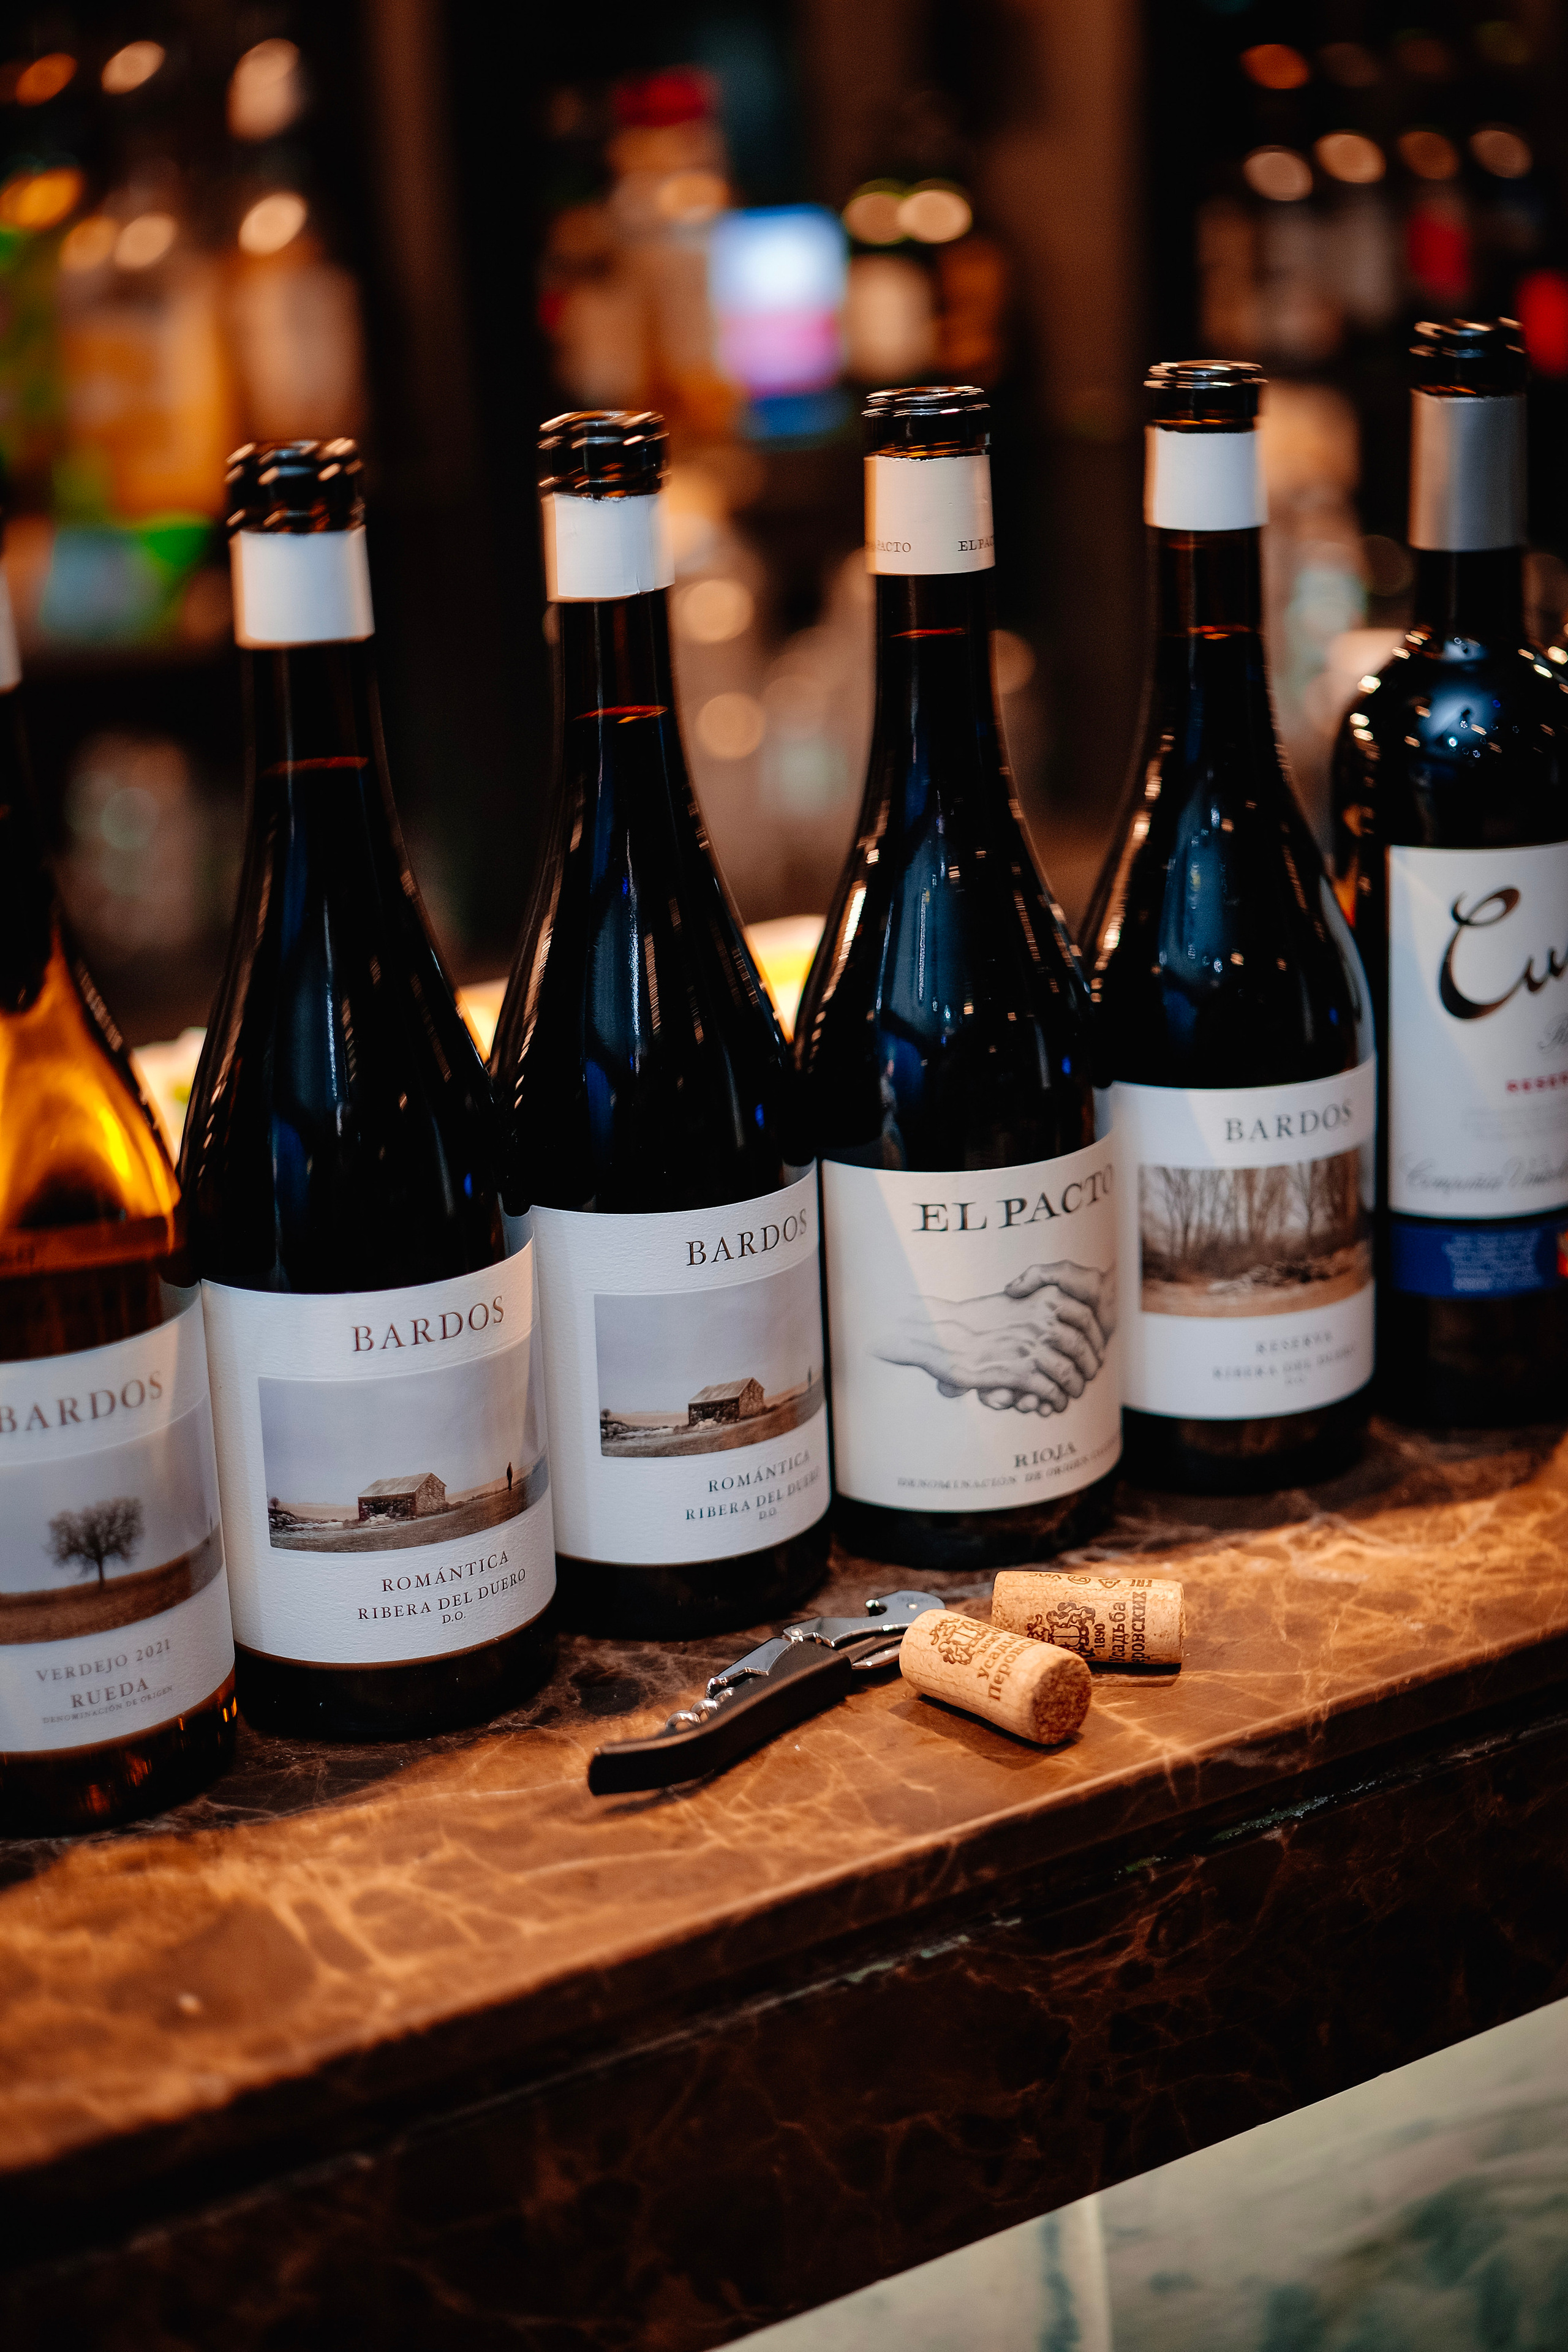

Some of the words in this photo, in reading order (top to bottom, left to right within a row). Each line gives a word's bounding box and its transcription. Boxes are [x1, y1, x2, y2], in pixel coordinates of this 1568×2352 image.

[957, 540, 978, 552] EL
[1225, 1099, 1352, 1143] BARDOS
[686, 1208, 808, 1266] BARDOS
[912, 1202, 988, 1232] EL
[352, 1295, 505, 1352] BARDOS
[0, 1371, 162, 1433] BARDOS
[708, 1449, 810, 1492] ROMÁNTICA
[1014, 1441, 1077, 1468] RIOJA
[685, 1501, 750, 1520] RIBERA
[756, 1489, 783, 1507] DEL
[381, 1550, 509, 1592] ROMÁNTICA
[358, 1602, 431, 1620] RIBERA
[437, 1592, 473, 1610] DEL
[478, 1569, 526, 1600] DUERO
[442, 1611, 466, 1624] D.O.
[1094, 1623, 1105, 1648] 1890
[1109, 1602, 1131, 1661] Усадьба
[36, 1654, 128, 1681] VERDEJO
[137, 1638, 171, 1662] 2021
[977, 1635, 1001, 1654] 1890
[988, 1640, 1042, 1702] Перовс
[70, 1678, 149, 1708] RUEDA
[126, 1698, 138, 1707] DE
[140, 1685, 173, 1703] ORIGEN
